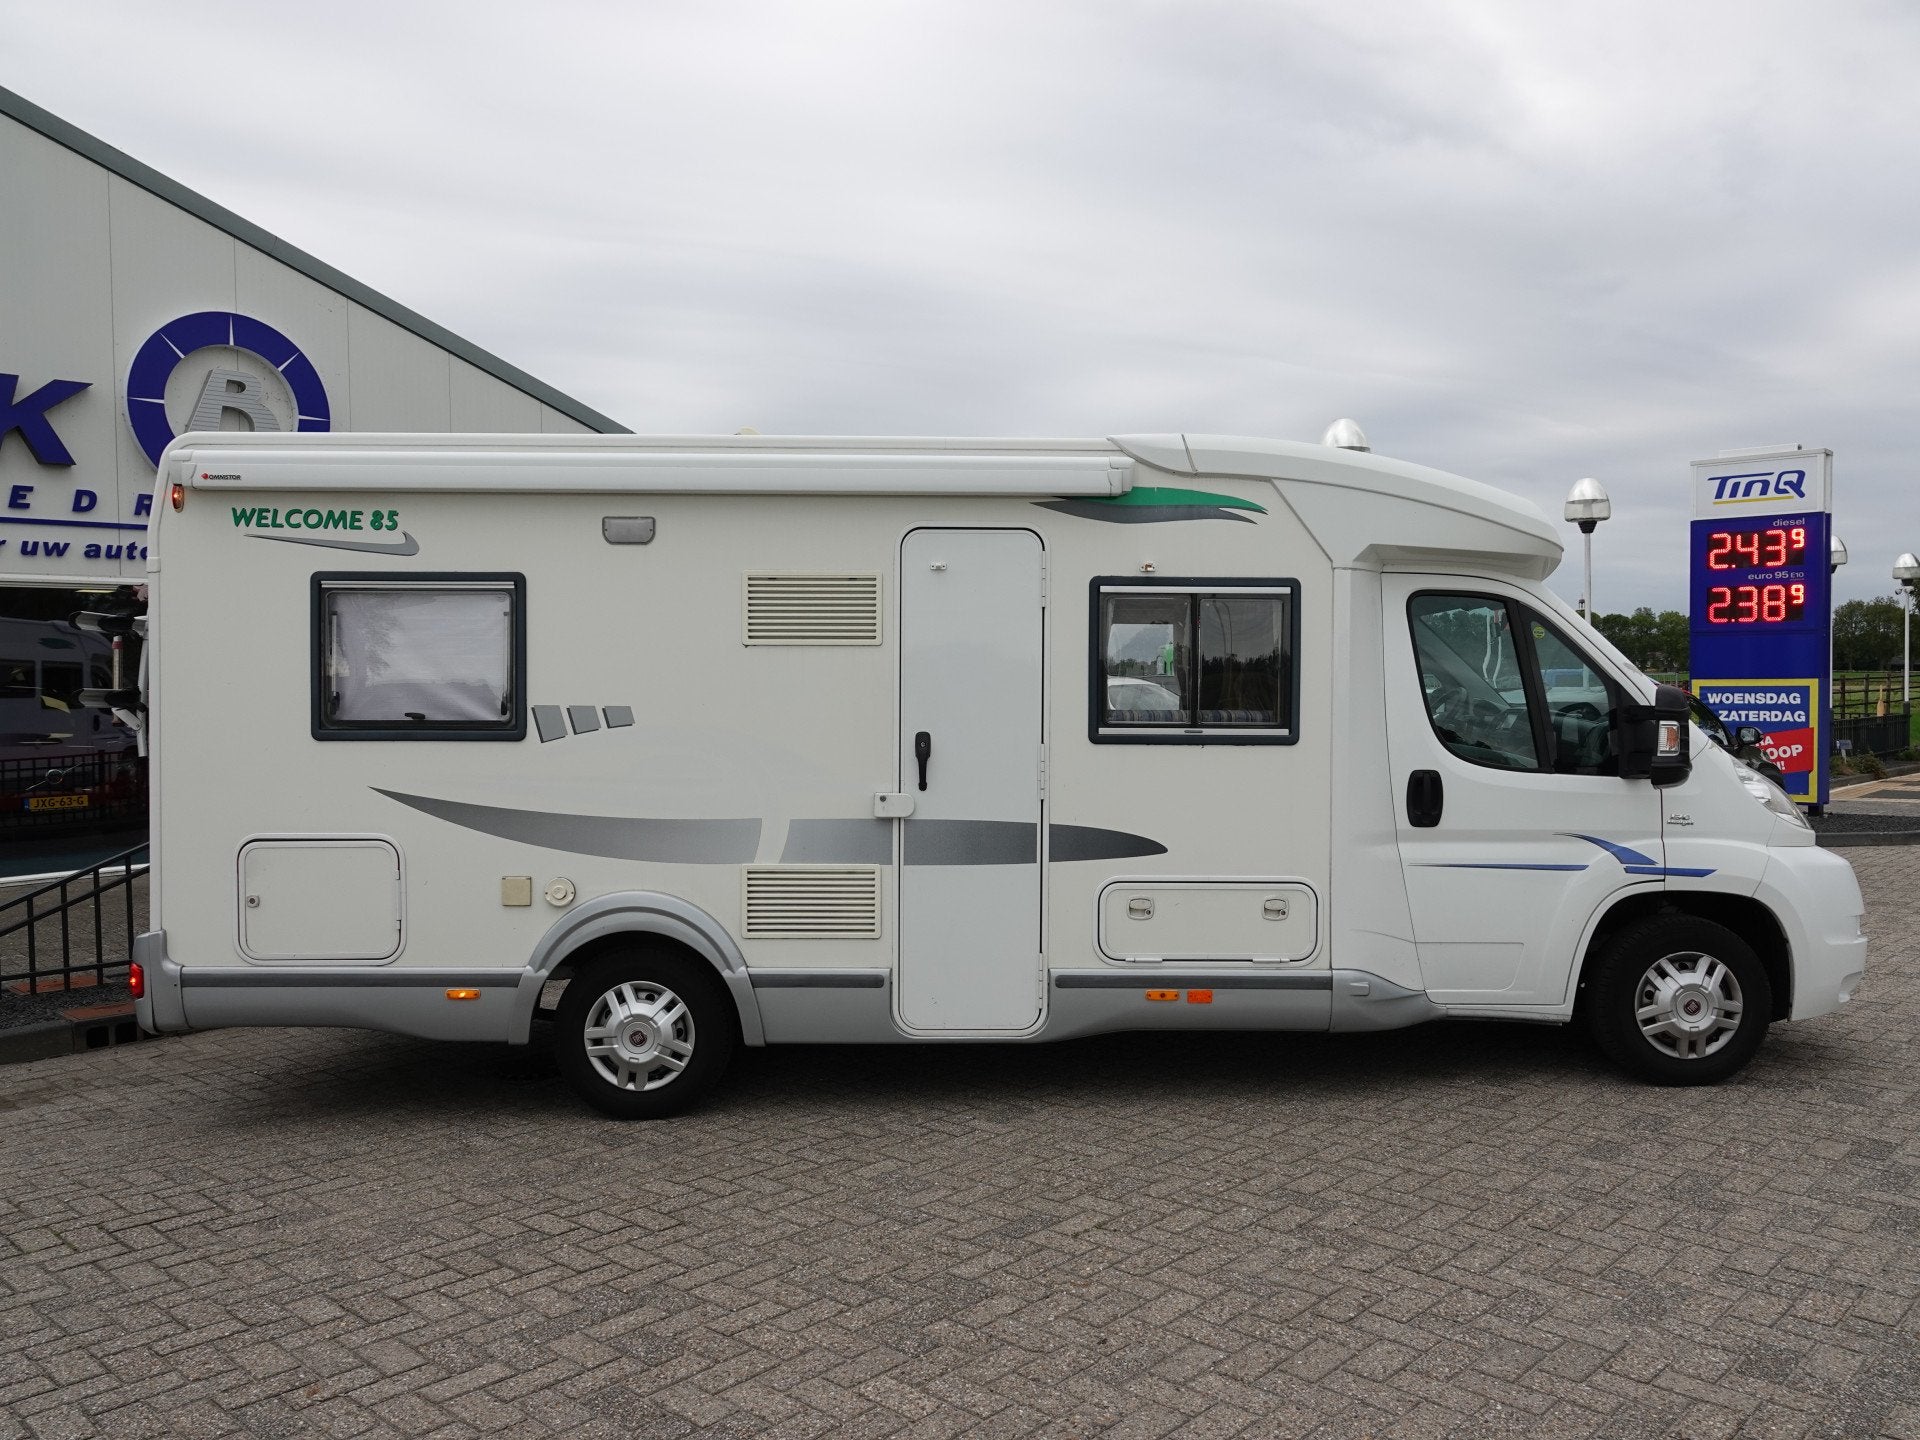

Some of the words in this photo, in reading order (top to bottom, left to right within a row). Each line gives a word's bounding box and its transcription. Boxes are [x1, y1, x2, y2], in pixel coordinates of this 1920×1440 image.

[231, 507, 363, 530] WELCOME
[370, 510, 399, 531] 85
[1773, 517, 1805, 527] diesel
[20, 540, 71, 557] uw
[1774, 570, 1789, 579] 95
[1707, 692, 1801, 705] WOENSDAG
[1718, 710, 1806, 722] ZATERDAG
